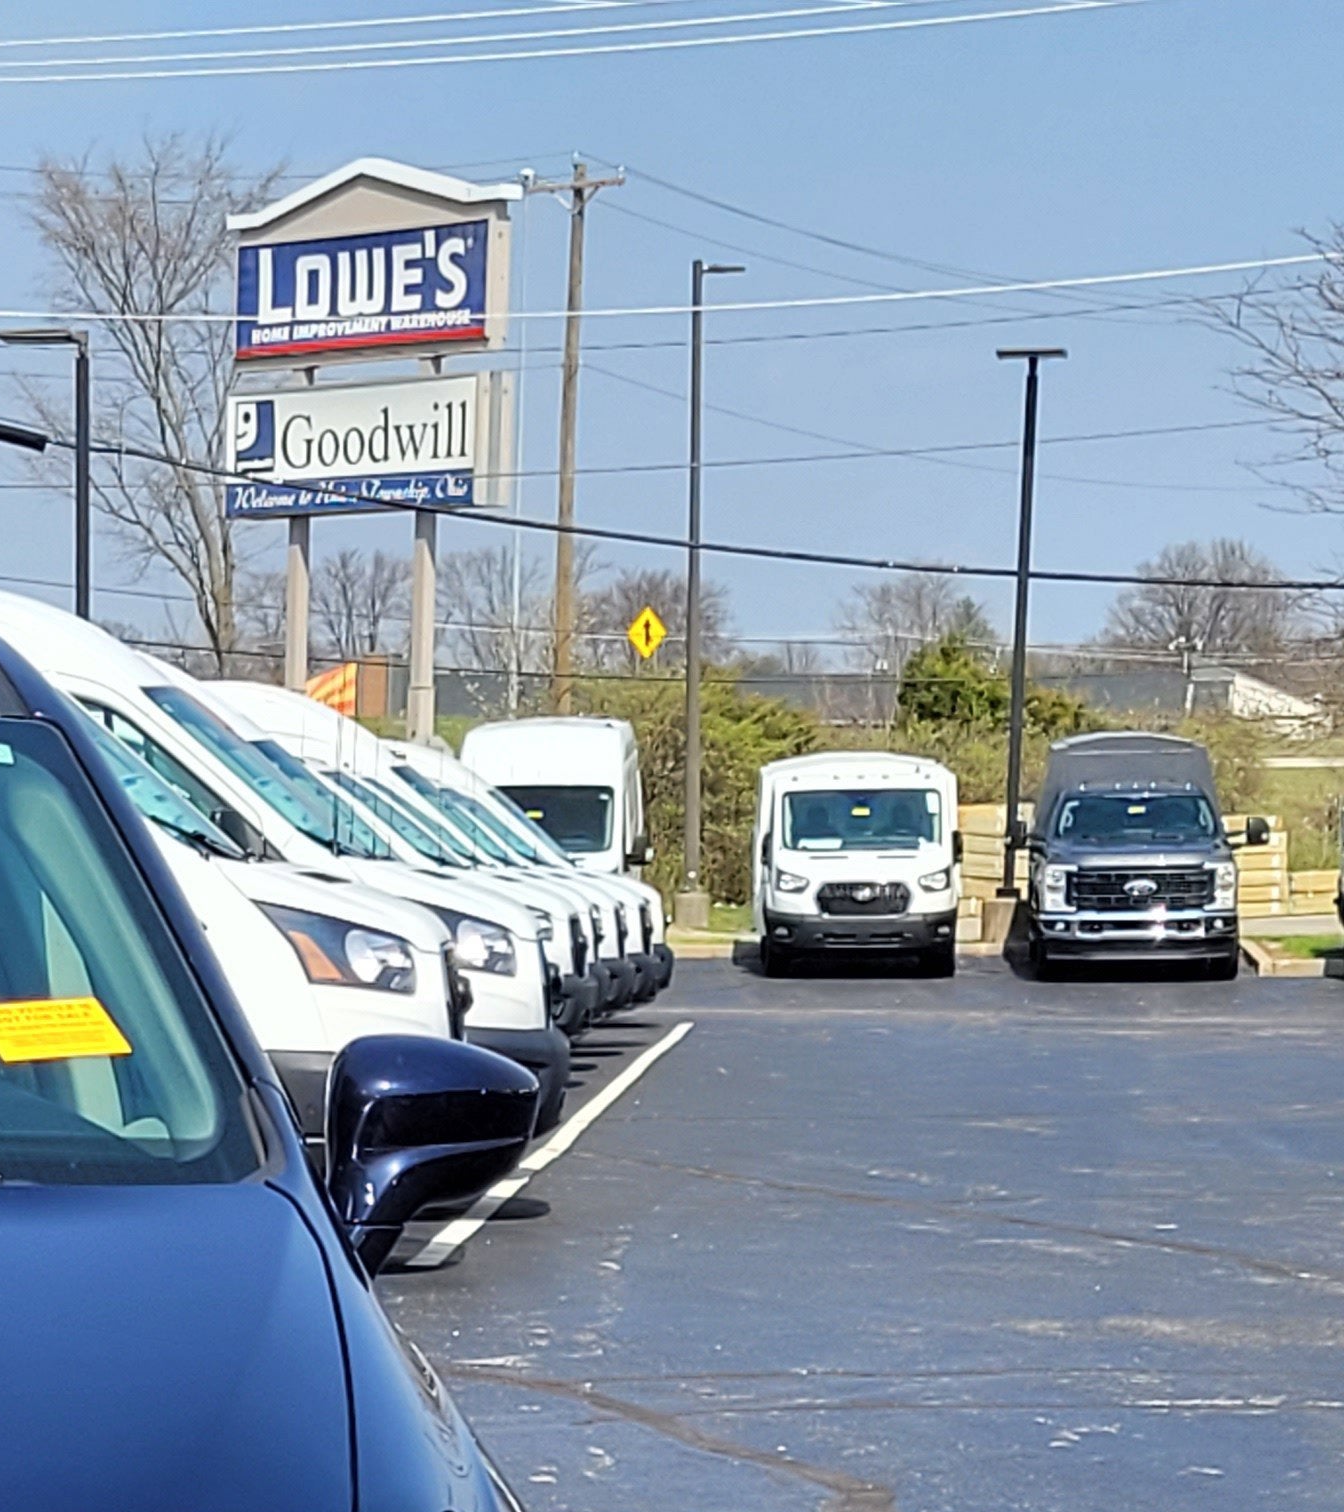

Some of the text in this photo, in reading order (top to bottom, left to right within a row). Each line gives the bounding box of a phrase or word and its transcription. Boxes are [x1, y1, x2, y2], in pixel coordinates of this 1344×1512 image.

[257, 230, 468, 324] LOWE'S
[251, 326, 291, 345] HOME
[292, 316, 389, 341] IMPROVEMENT
[281, 400, 469, 470] Goodwill
